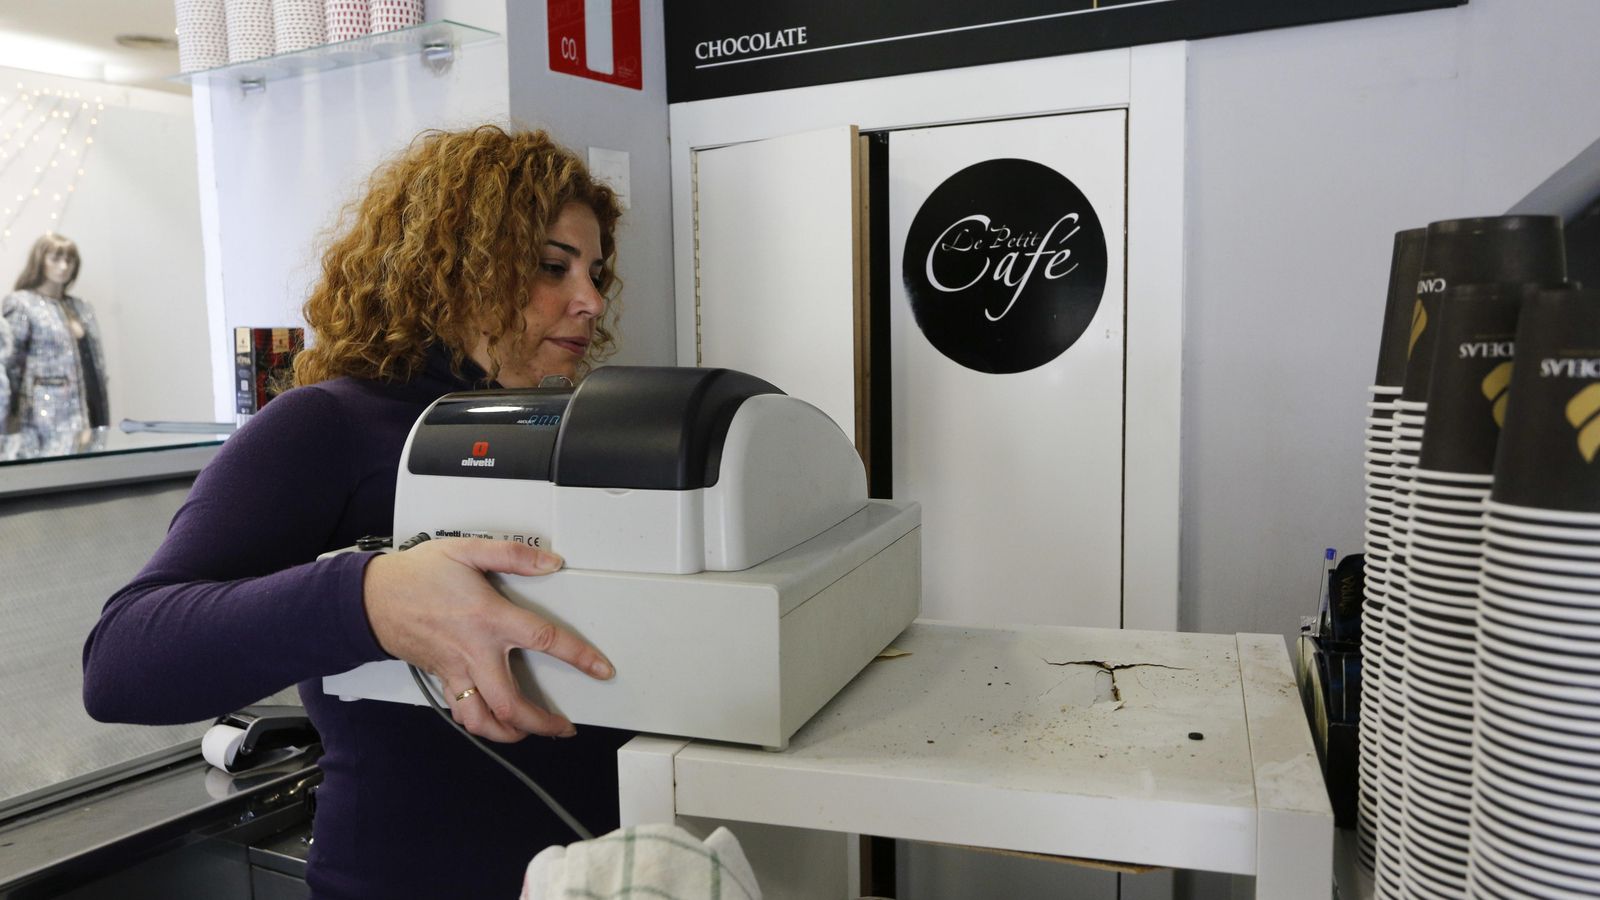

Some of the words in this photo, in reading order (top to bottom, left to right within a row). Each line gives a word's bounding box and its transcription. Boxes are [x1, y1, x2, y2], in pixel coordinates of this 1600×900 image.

[695, 26, 808, 60] CHOCOLATE
[941, 229, 984, 252] Le
[989, 224, 1041, 249] Petit
[925, 212, 1081, 322] Café
[461, 457, 496, 467] olivetti
[435, 529, 461, 538] olivetti
